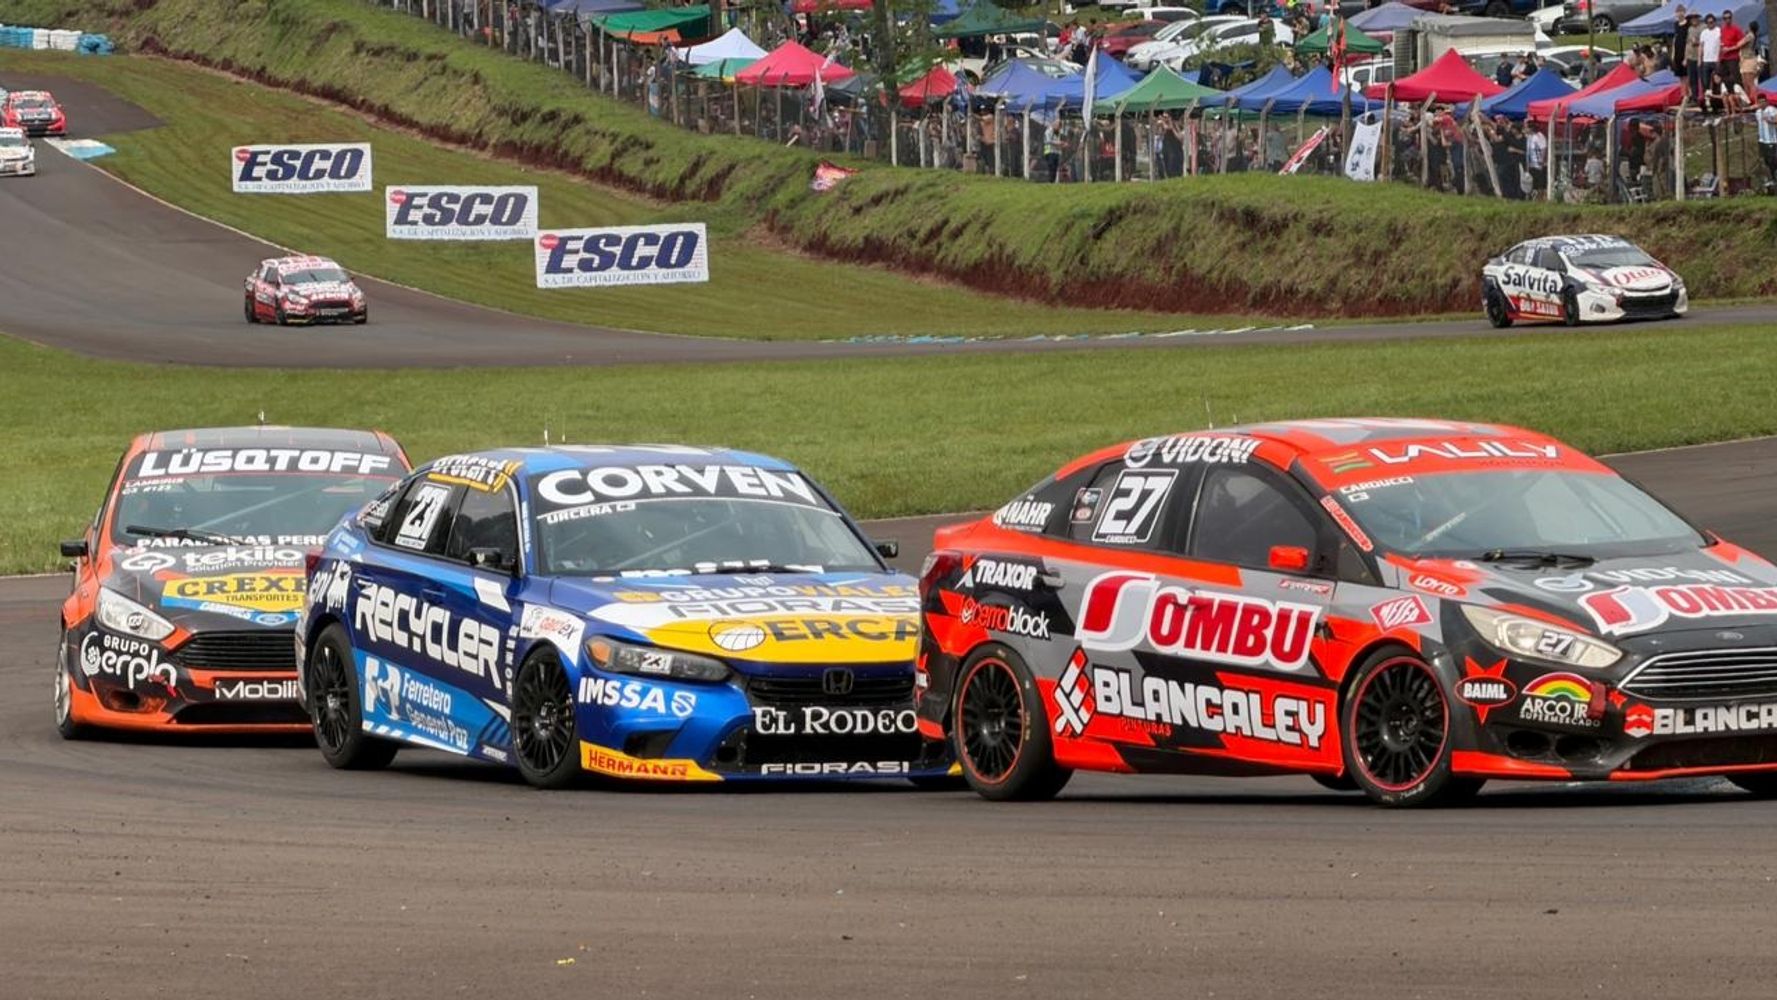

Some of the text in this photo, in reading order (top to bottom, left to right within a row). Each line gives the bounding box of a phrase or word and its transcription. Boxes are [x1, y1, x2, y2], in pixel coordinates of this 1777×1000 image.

[238, 148, 364, 182] ESCO
[392, 191, 528, 226] ESCO
[544, 231, 699, 274] ESCO
[1501, 265, 1559, 294] Salvita
[138, 448, 390, 477] LÜSQTOFF
[1161, 437, 1262, 464] VIDONI
[538, 464, 817, 505] CORVEN
[1340, 476, 1414, 494] CARDUCCI
[546, 505, 613, 524] URCERA
[1099, 475, 1172, 535] 27
[182, 546, 303, 567] tekilo
[186, 558, 300, 573] Solution Provider
[975, 559, 1037, 590] TRAXOR
[1655, 587, 1777, 614] OMB
[1149, 590, 1316, 665] OMBU
[103, 633, 149, 656] GRUPO
[1538, 632, 1574, 655] 27
[578, 677, 667, 715] IMSSA
[1462, 682, 1508, 700] BAIML
[752, 707, 918, 735] EL RODEO
[1093, 668, 1326, 748] BLANCALEY
[1520, 697, 1571, 718] ARCO
[1520, 711, 1601, 727] SUPERMERCADO
[1653, 703, 1777, 735] BLANCA
[588, 748, 689, 777] HERMANN
[760, 760, 910, 776] FIORASI
